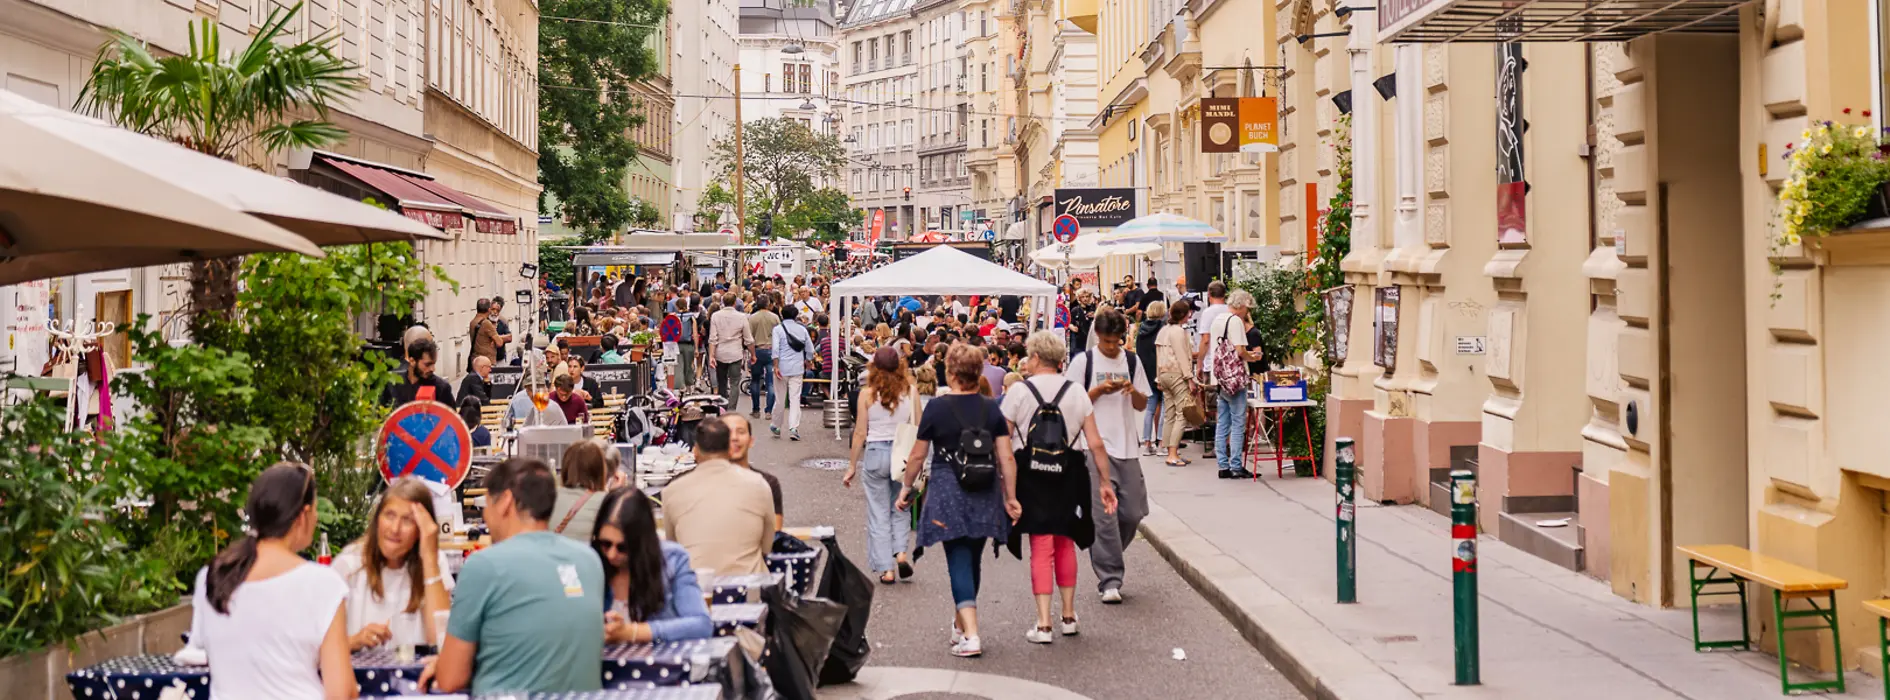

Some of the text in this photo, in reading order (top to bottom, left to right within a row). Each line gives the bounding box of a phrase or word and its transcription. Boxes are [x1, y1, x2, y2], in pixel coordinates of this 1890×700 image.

[1244, 123, 1271, 131] PLANET
[1248, 131, 1268, 139] BUCH
[1059, 195, 1130, 215] Pinsatore
[1030, 460, 1062, 473] Bench
[441, 522, 450, 534] G
